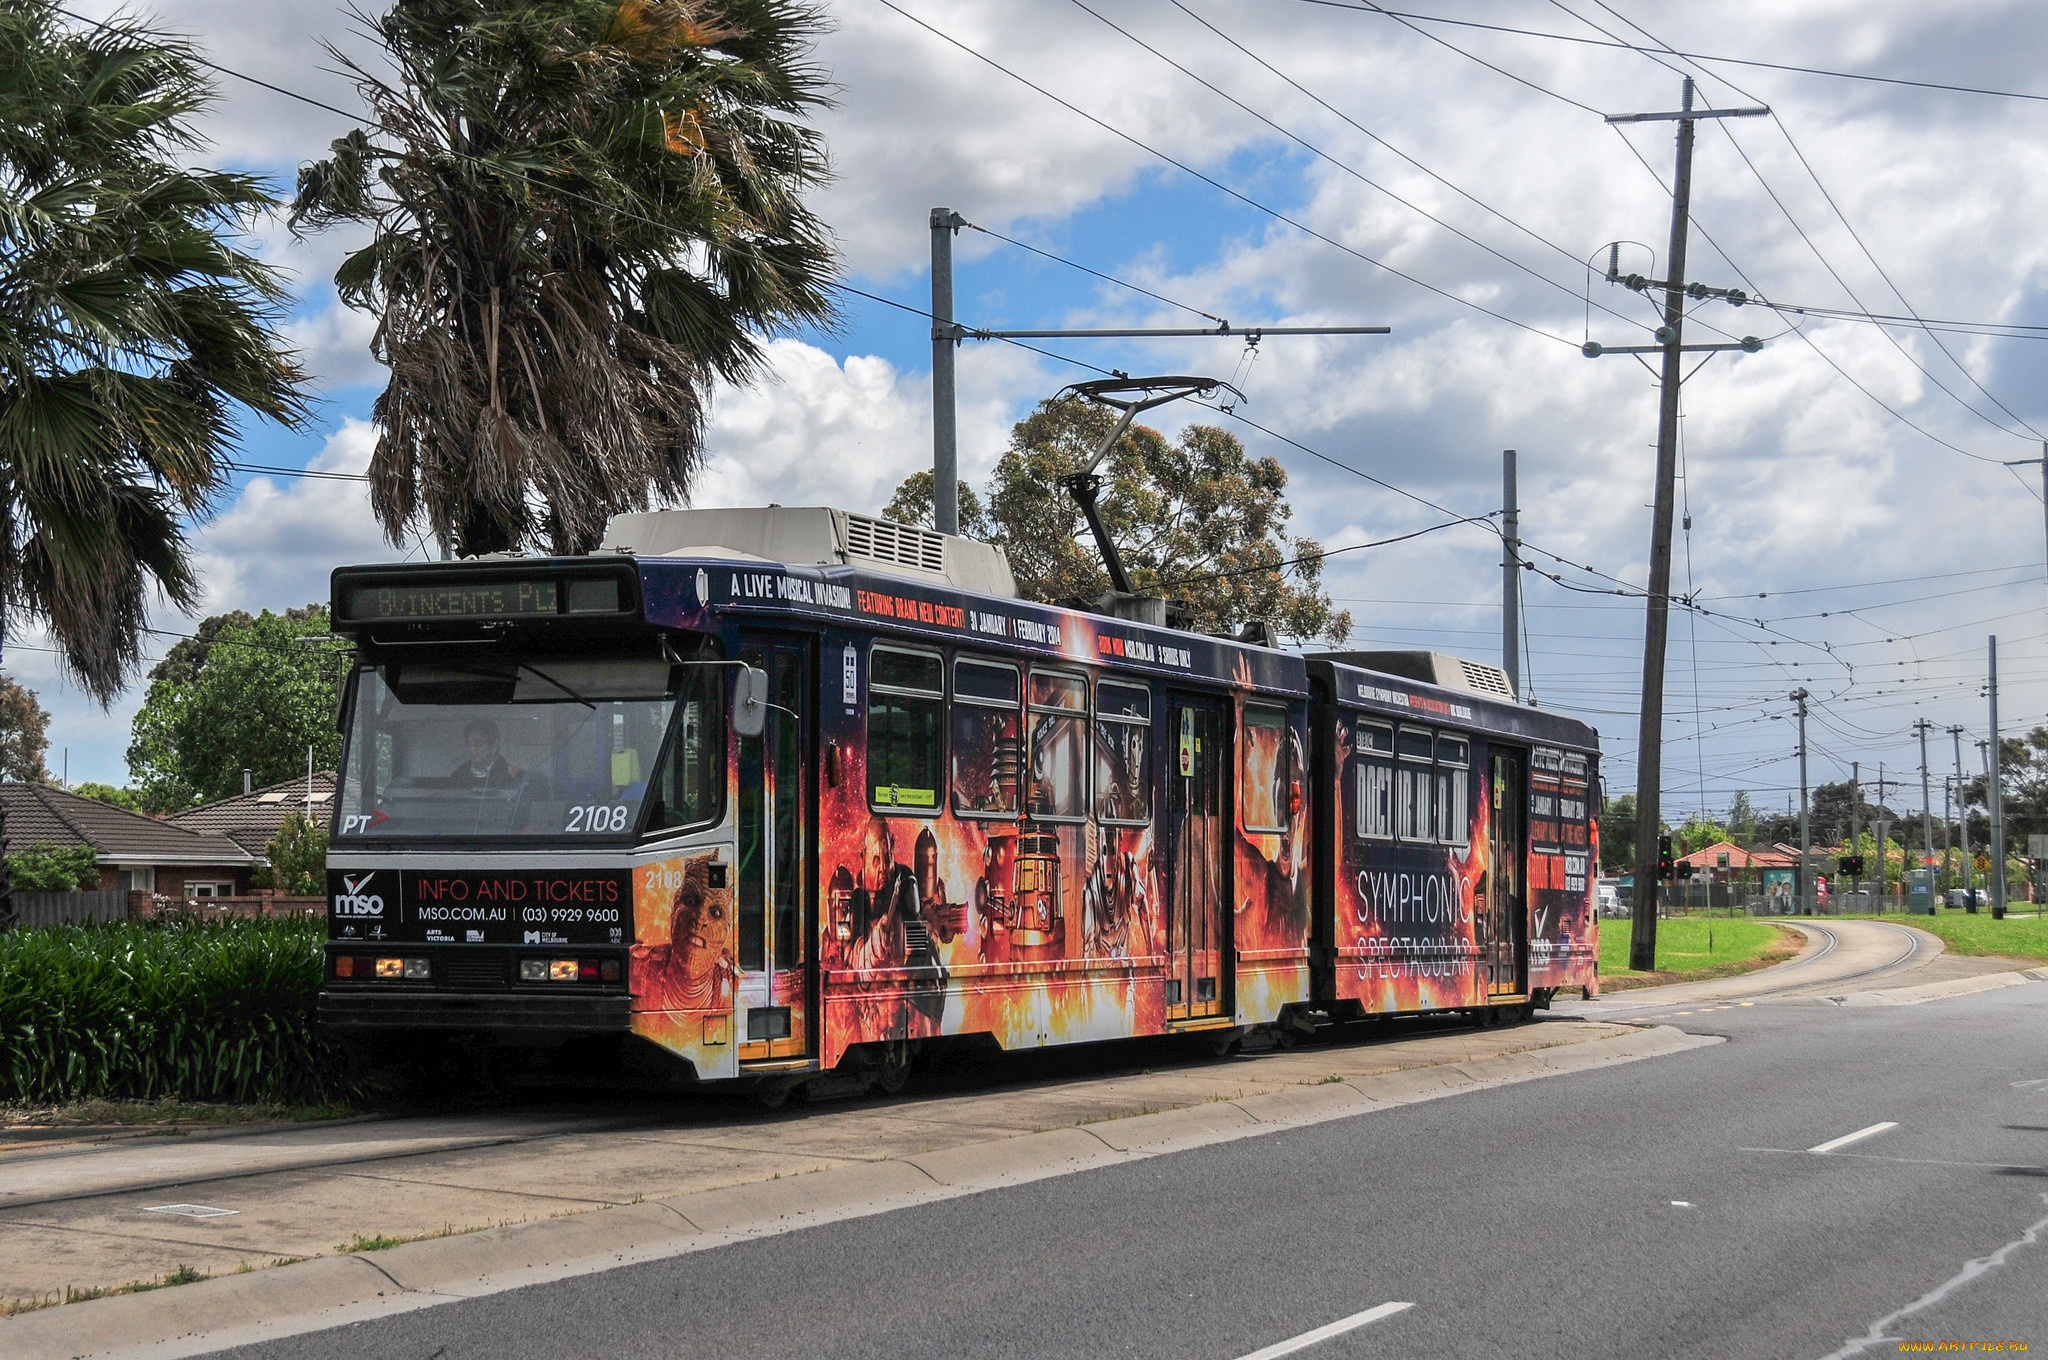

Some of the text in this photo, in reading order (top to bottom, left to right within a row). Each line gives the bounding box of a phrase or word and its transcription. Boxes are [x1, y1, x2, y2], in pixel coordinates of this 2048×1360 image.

[731, 573, 852, 610] A LIVE MUSICAL INVASION!
[857, 590, 966, 629] FEATURING BRAND NEW CONTENT!
[565, 805, 629, 832] 2108
[418, 879, 619, 901] INFO AND TICKETS
[645, 870, 683, 889] 2108
[335, 895, 384, 915] mso
[1357, 870, 1471, 924] SYMPHONIC
[418, 906, 619, 922] MSO.COM.AU (03) 9929 9600
[1358, 937, 1473, 980] SPECTACULAR
